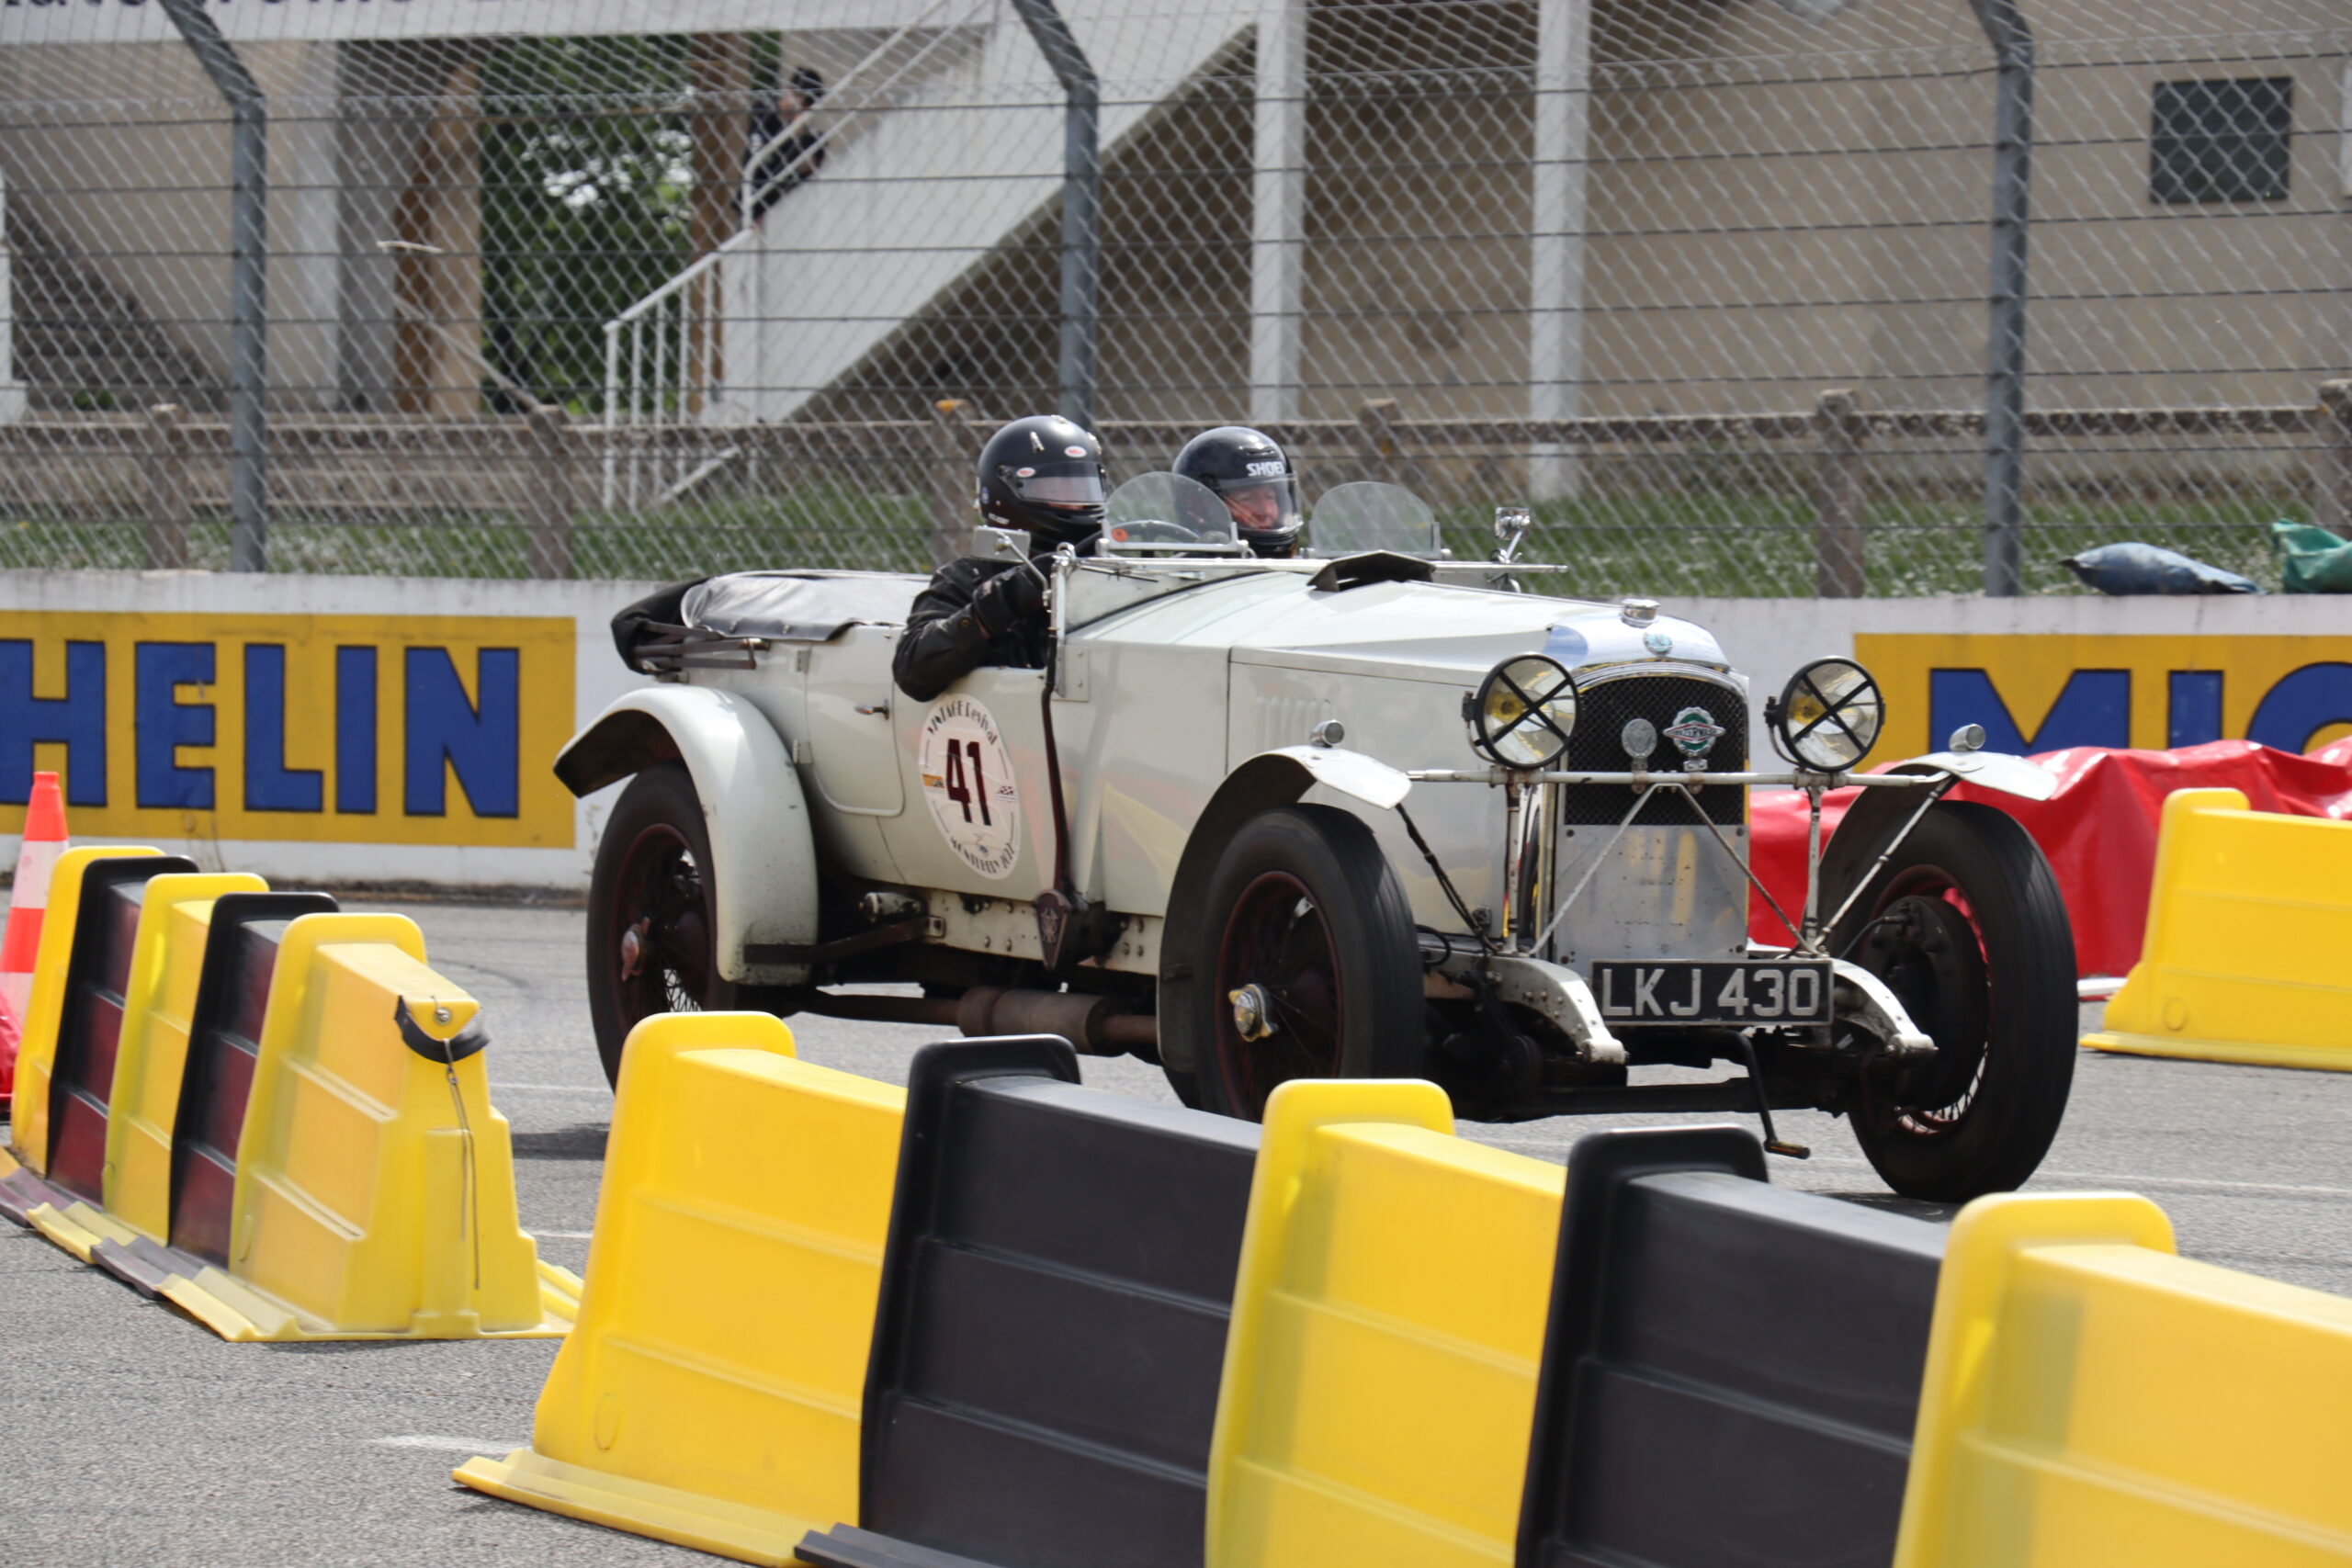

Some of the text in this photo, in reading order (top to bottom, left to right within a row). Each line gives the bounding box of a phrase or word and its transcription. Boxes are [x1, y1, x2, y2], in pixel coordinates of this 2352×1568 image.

[0, 638, 519, 818] HELIN
[946, 739, 992, 826] 41
[1602, 968, 1820, 1017] LKJ 430
